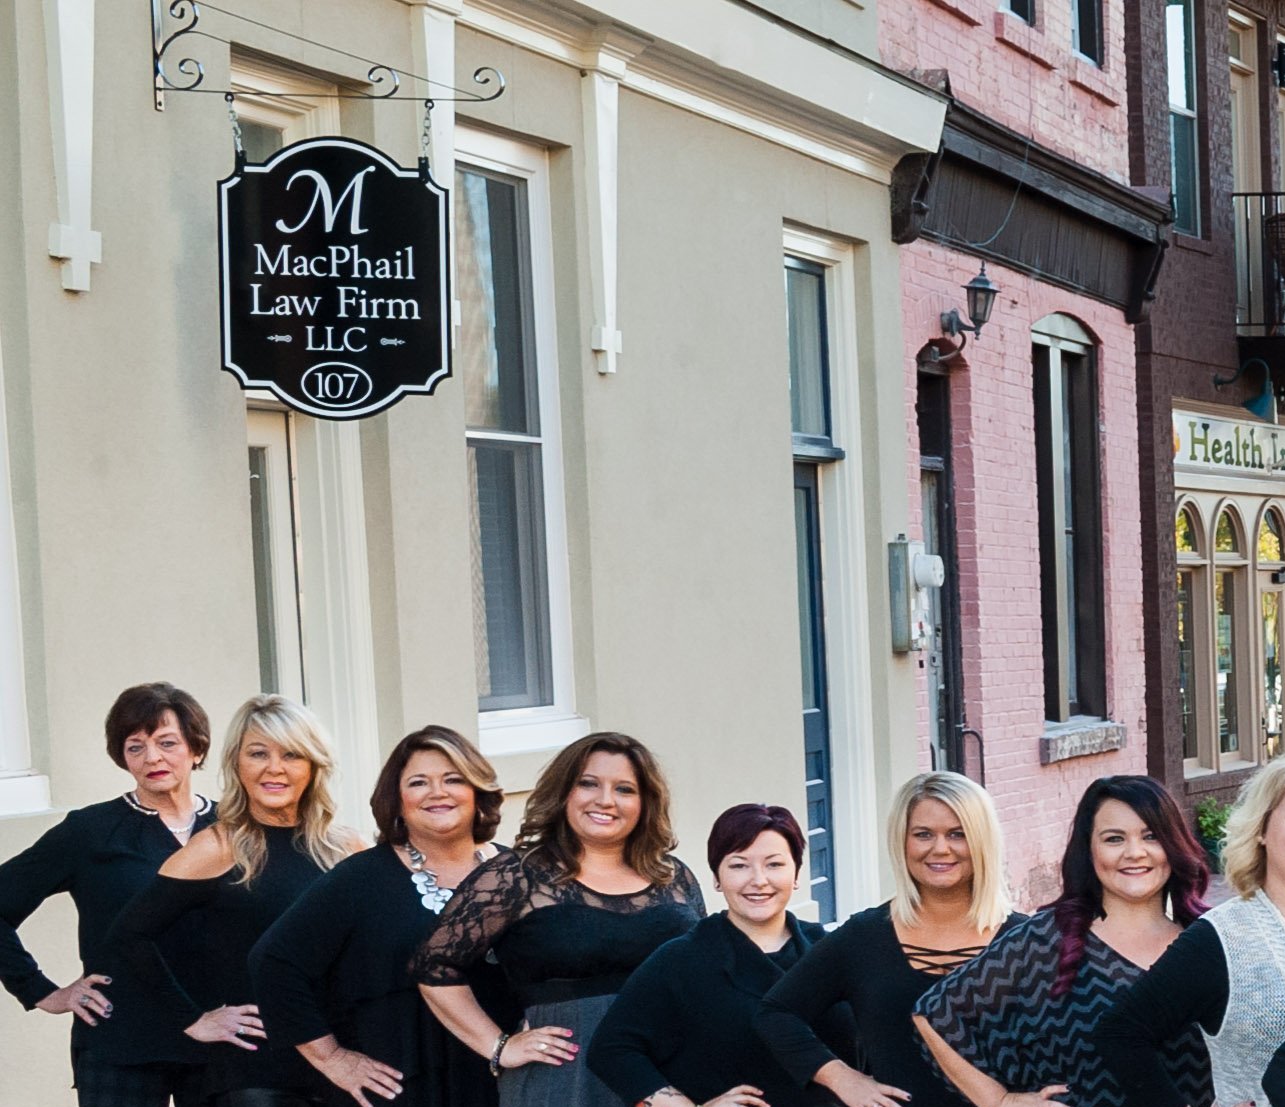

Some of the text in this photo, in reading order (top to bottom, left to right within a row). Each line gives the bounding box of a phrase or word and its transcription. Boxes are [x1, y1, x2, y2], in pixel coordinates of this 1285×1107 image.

[275, 165, 376, 235] M
[253, 243, 416, 281] MacPhail
[250, 284, 421, 320] Law Firm
[305, 326, 368, 352] LLC
[313, 372, 360, 399] 107
[1188, 420, 1265, 470] Health
